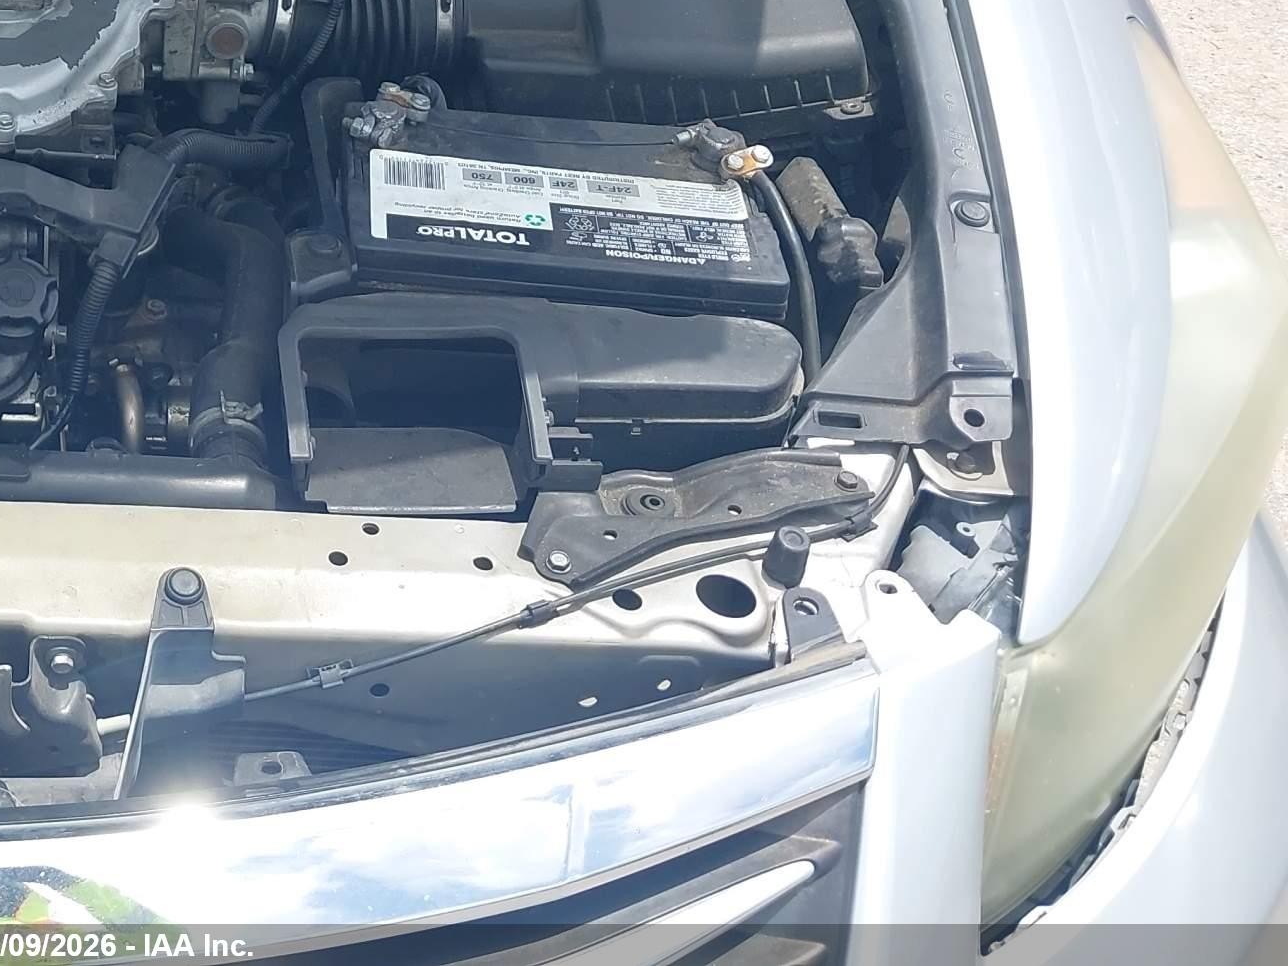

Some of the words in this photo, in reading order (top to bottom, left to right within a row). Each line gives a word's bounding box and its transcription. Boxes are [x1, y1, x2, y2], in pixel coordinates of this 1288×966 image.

[513, 176, 536, 184] 600
[551, 179, 575, 188] 24F
[595, 184, 631, 193] 24F-T
[417, 225, 530, 245] TOTALPRO
[606, 249, 696, 264] DANGER/POISON
